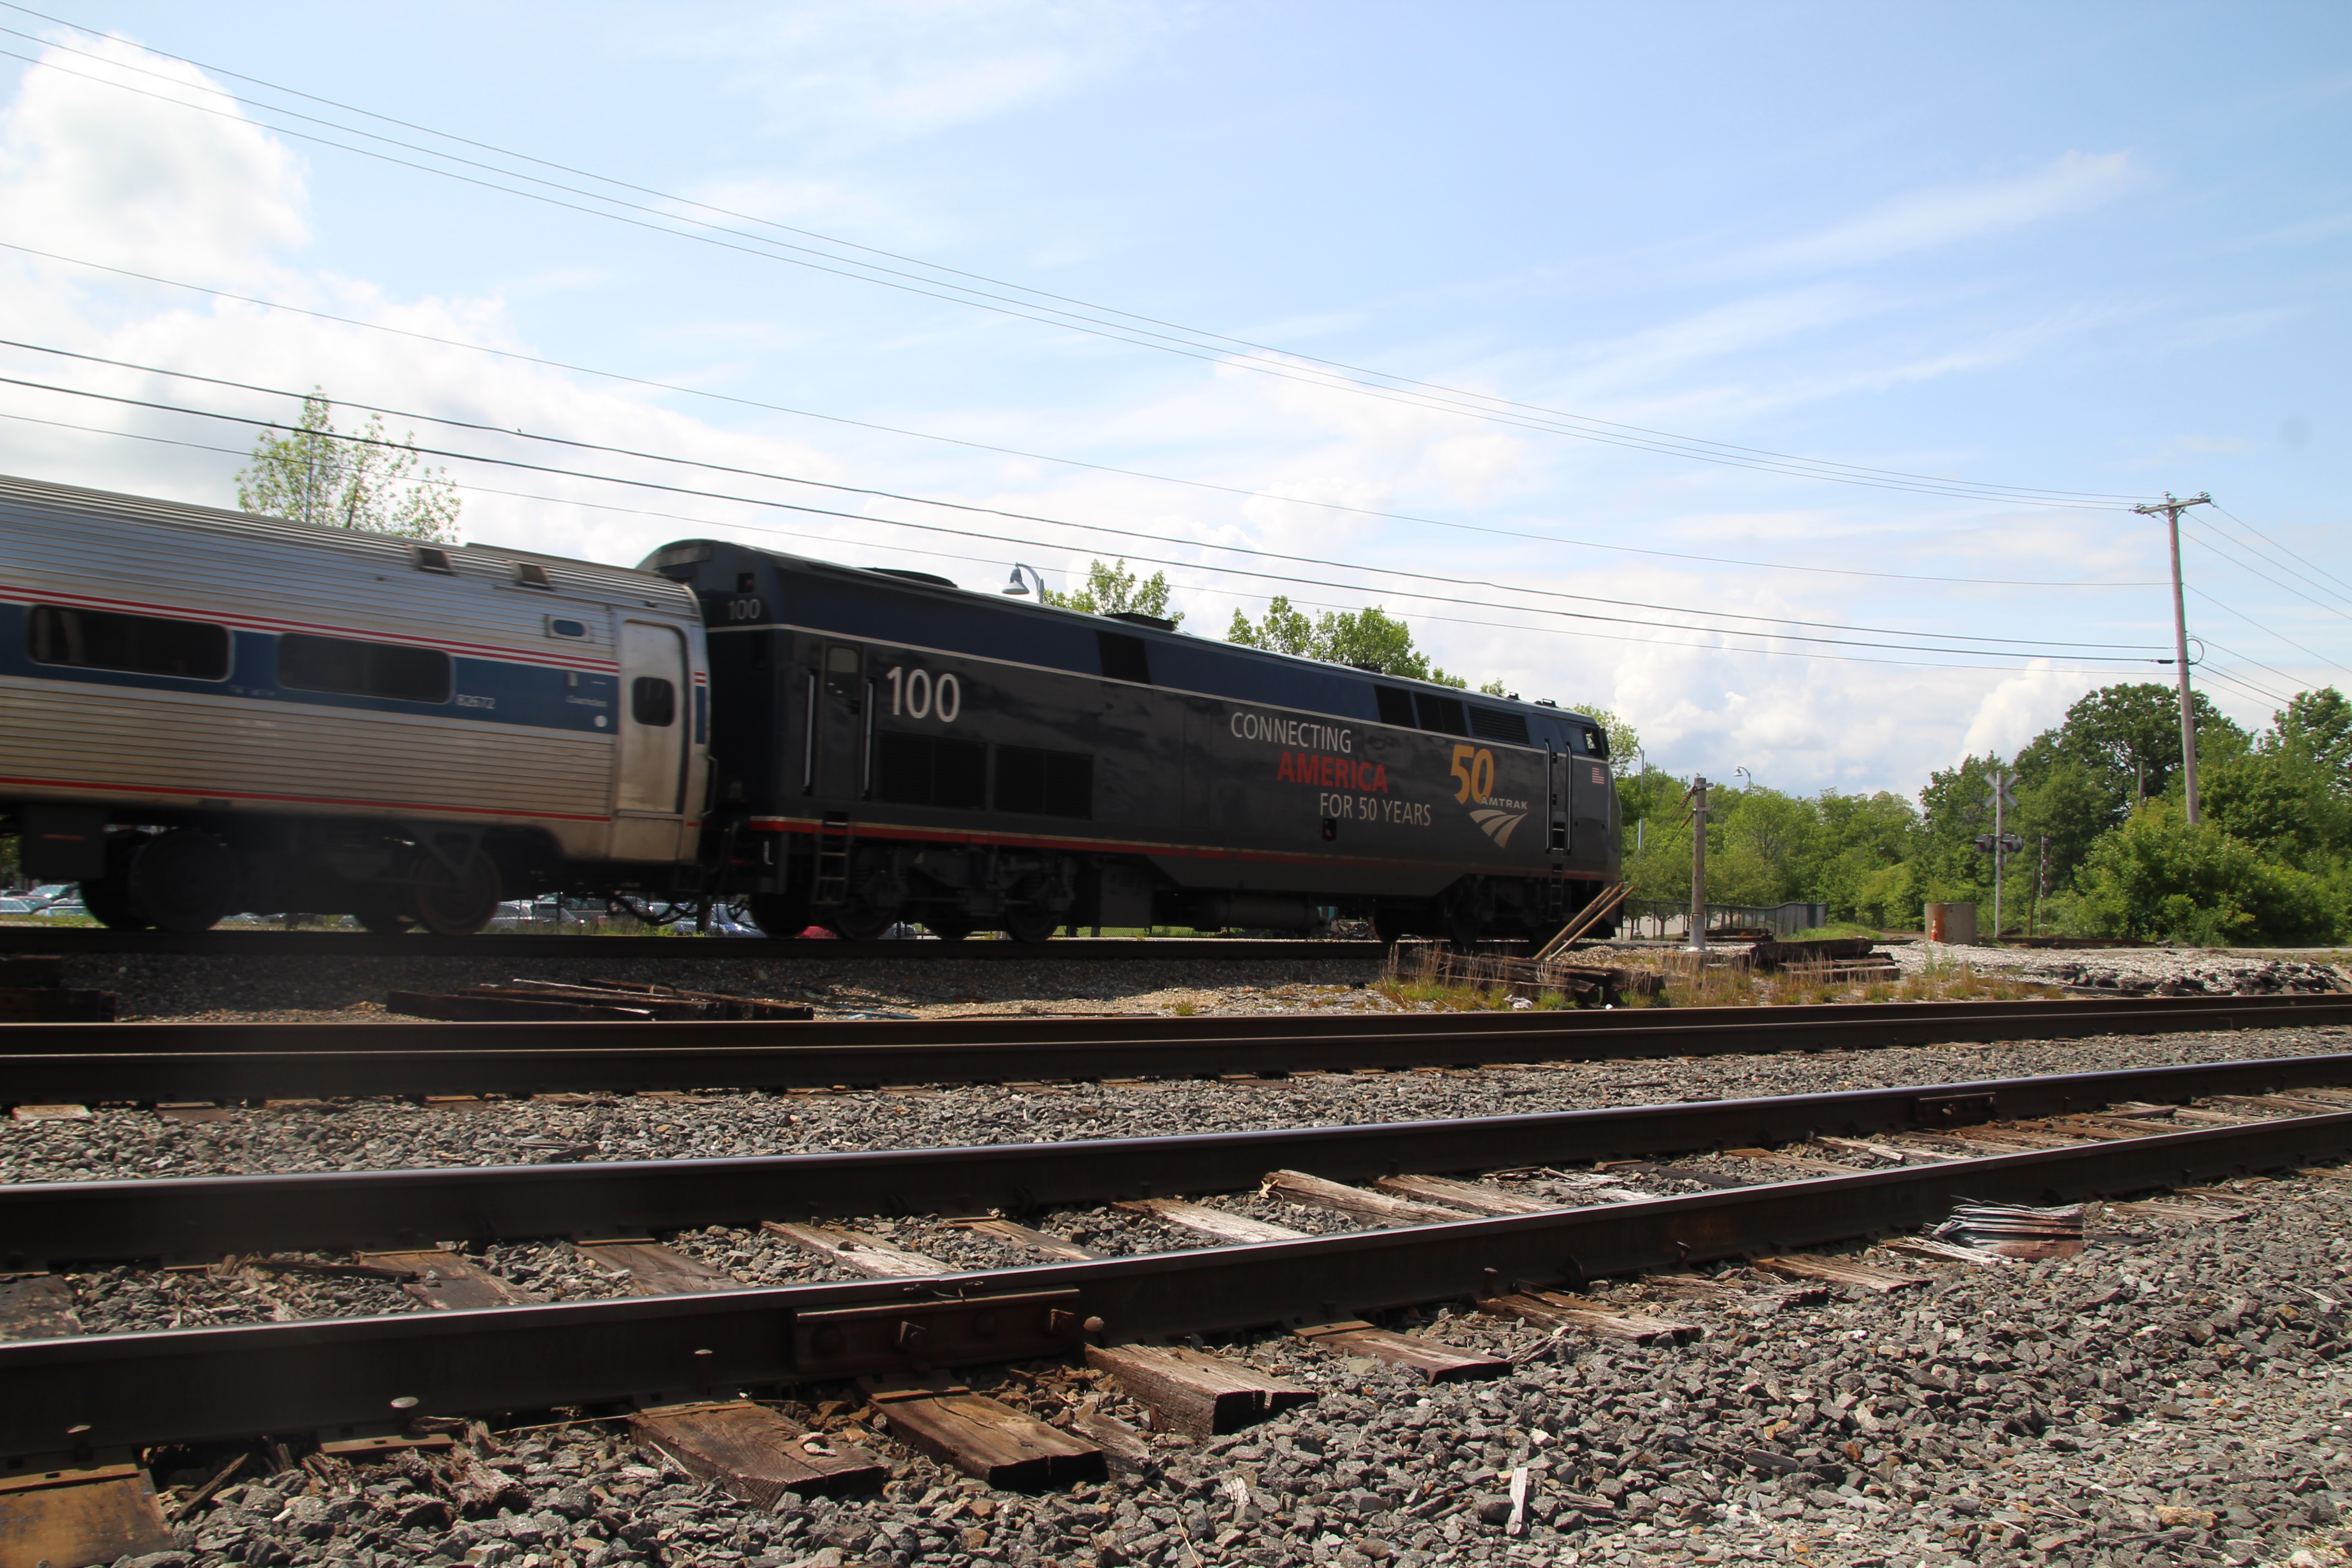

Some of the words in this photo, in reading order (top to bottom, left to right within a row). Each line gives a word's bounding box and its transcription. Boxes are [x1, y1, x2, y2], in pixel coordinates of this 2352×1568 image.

[727, 599, 760, 620] 100
[886, 666, 960, 722] 100
[1230, 712, 1351, 753] CONNECTING
[1276, 751, 1388, 793] AMERICA
[1450, 744, 1494, 805] 50
[1320, 793, 1353, 818] FOR
[1359, 797, 1377, 821] 50
[1382, 799, 1431, 826] YEARS
[1481, 796, 1528, 810] AMTRAK
